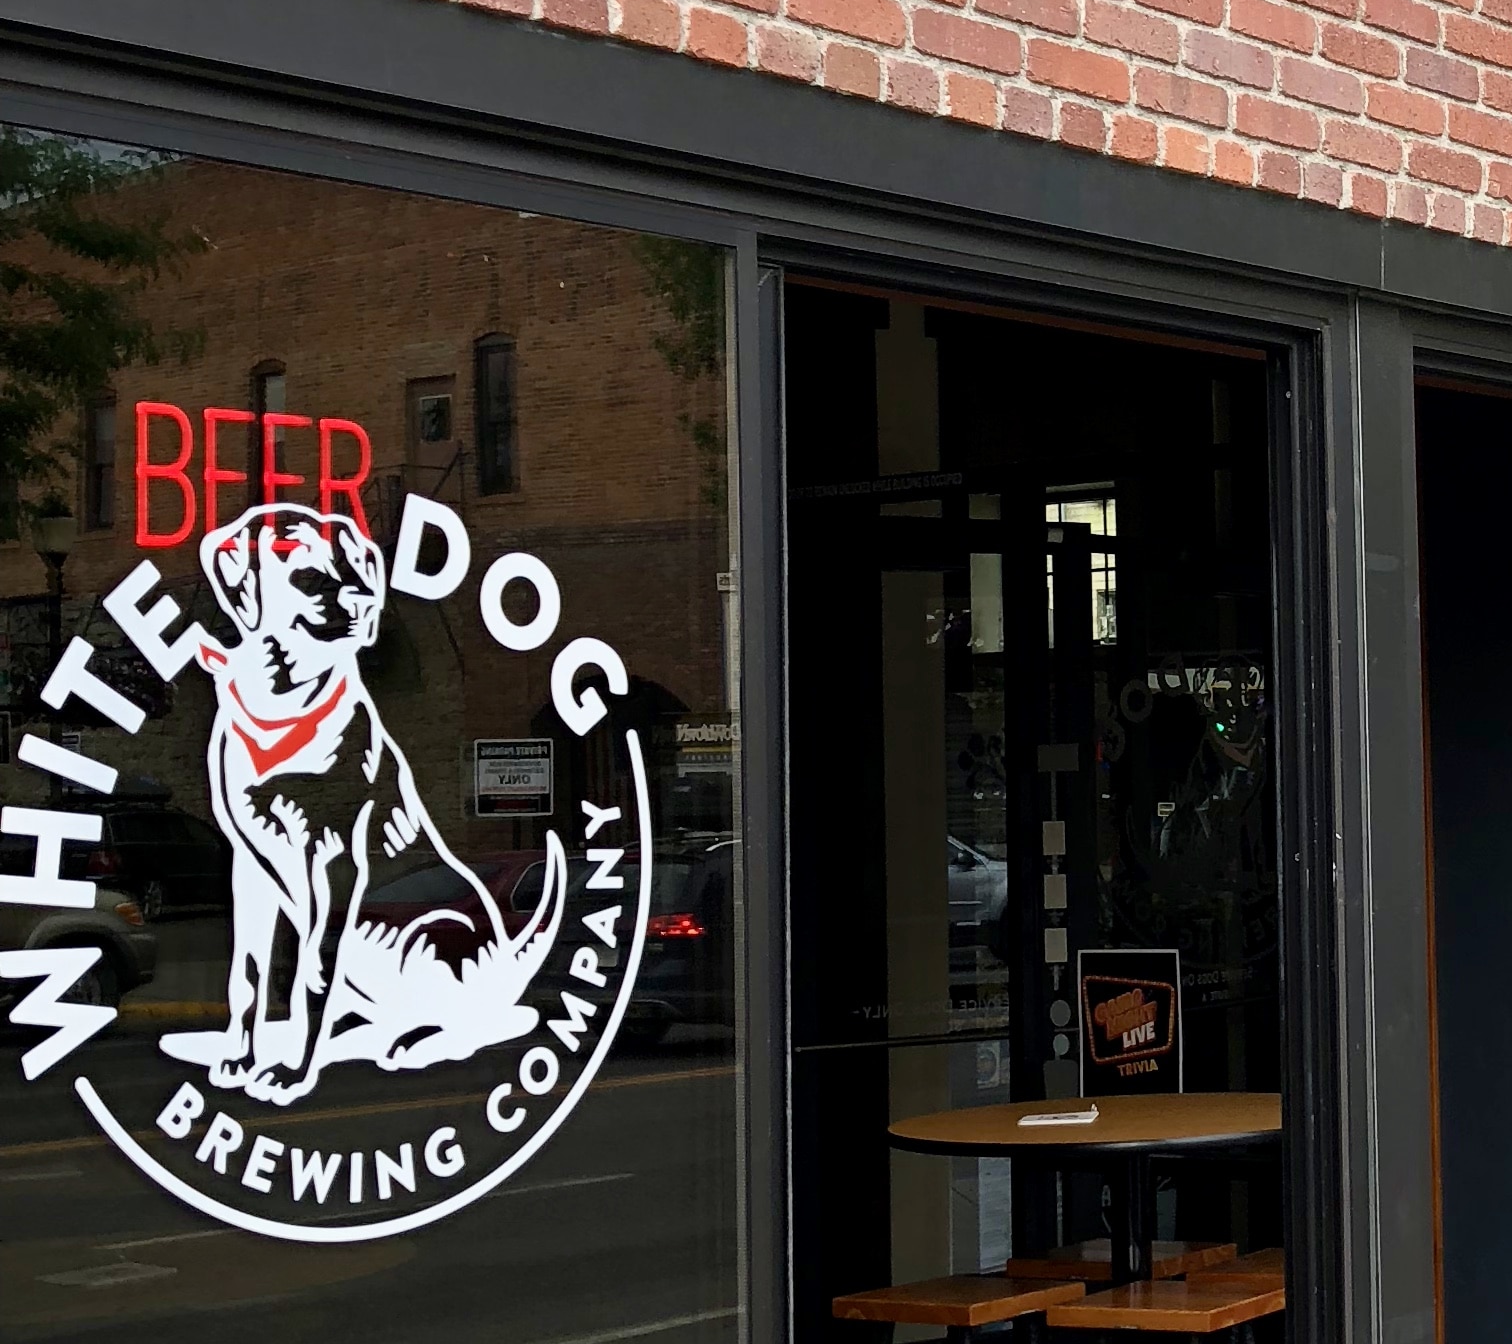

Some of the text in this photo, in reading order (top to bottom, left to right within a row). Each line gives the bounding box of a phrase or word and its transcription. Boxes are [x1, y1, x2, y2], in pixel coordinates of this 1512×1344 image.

[135, 400, 373, 553] BEER
[0, 492, 630, 1081] WHITE DOG
[156, 798, 622, 1205] BREWING COMPANY
[1117, 1059, 1159, 1077] TRIVIA
[1122, 1020, 1156, 1049] LIVE
